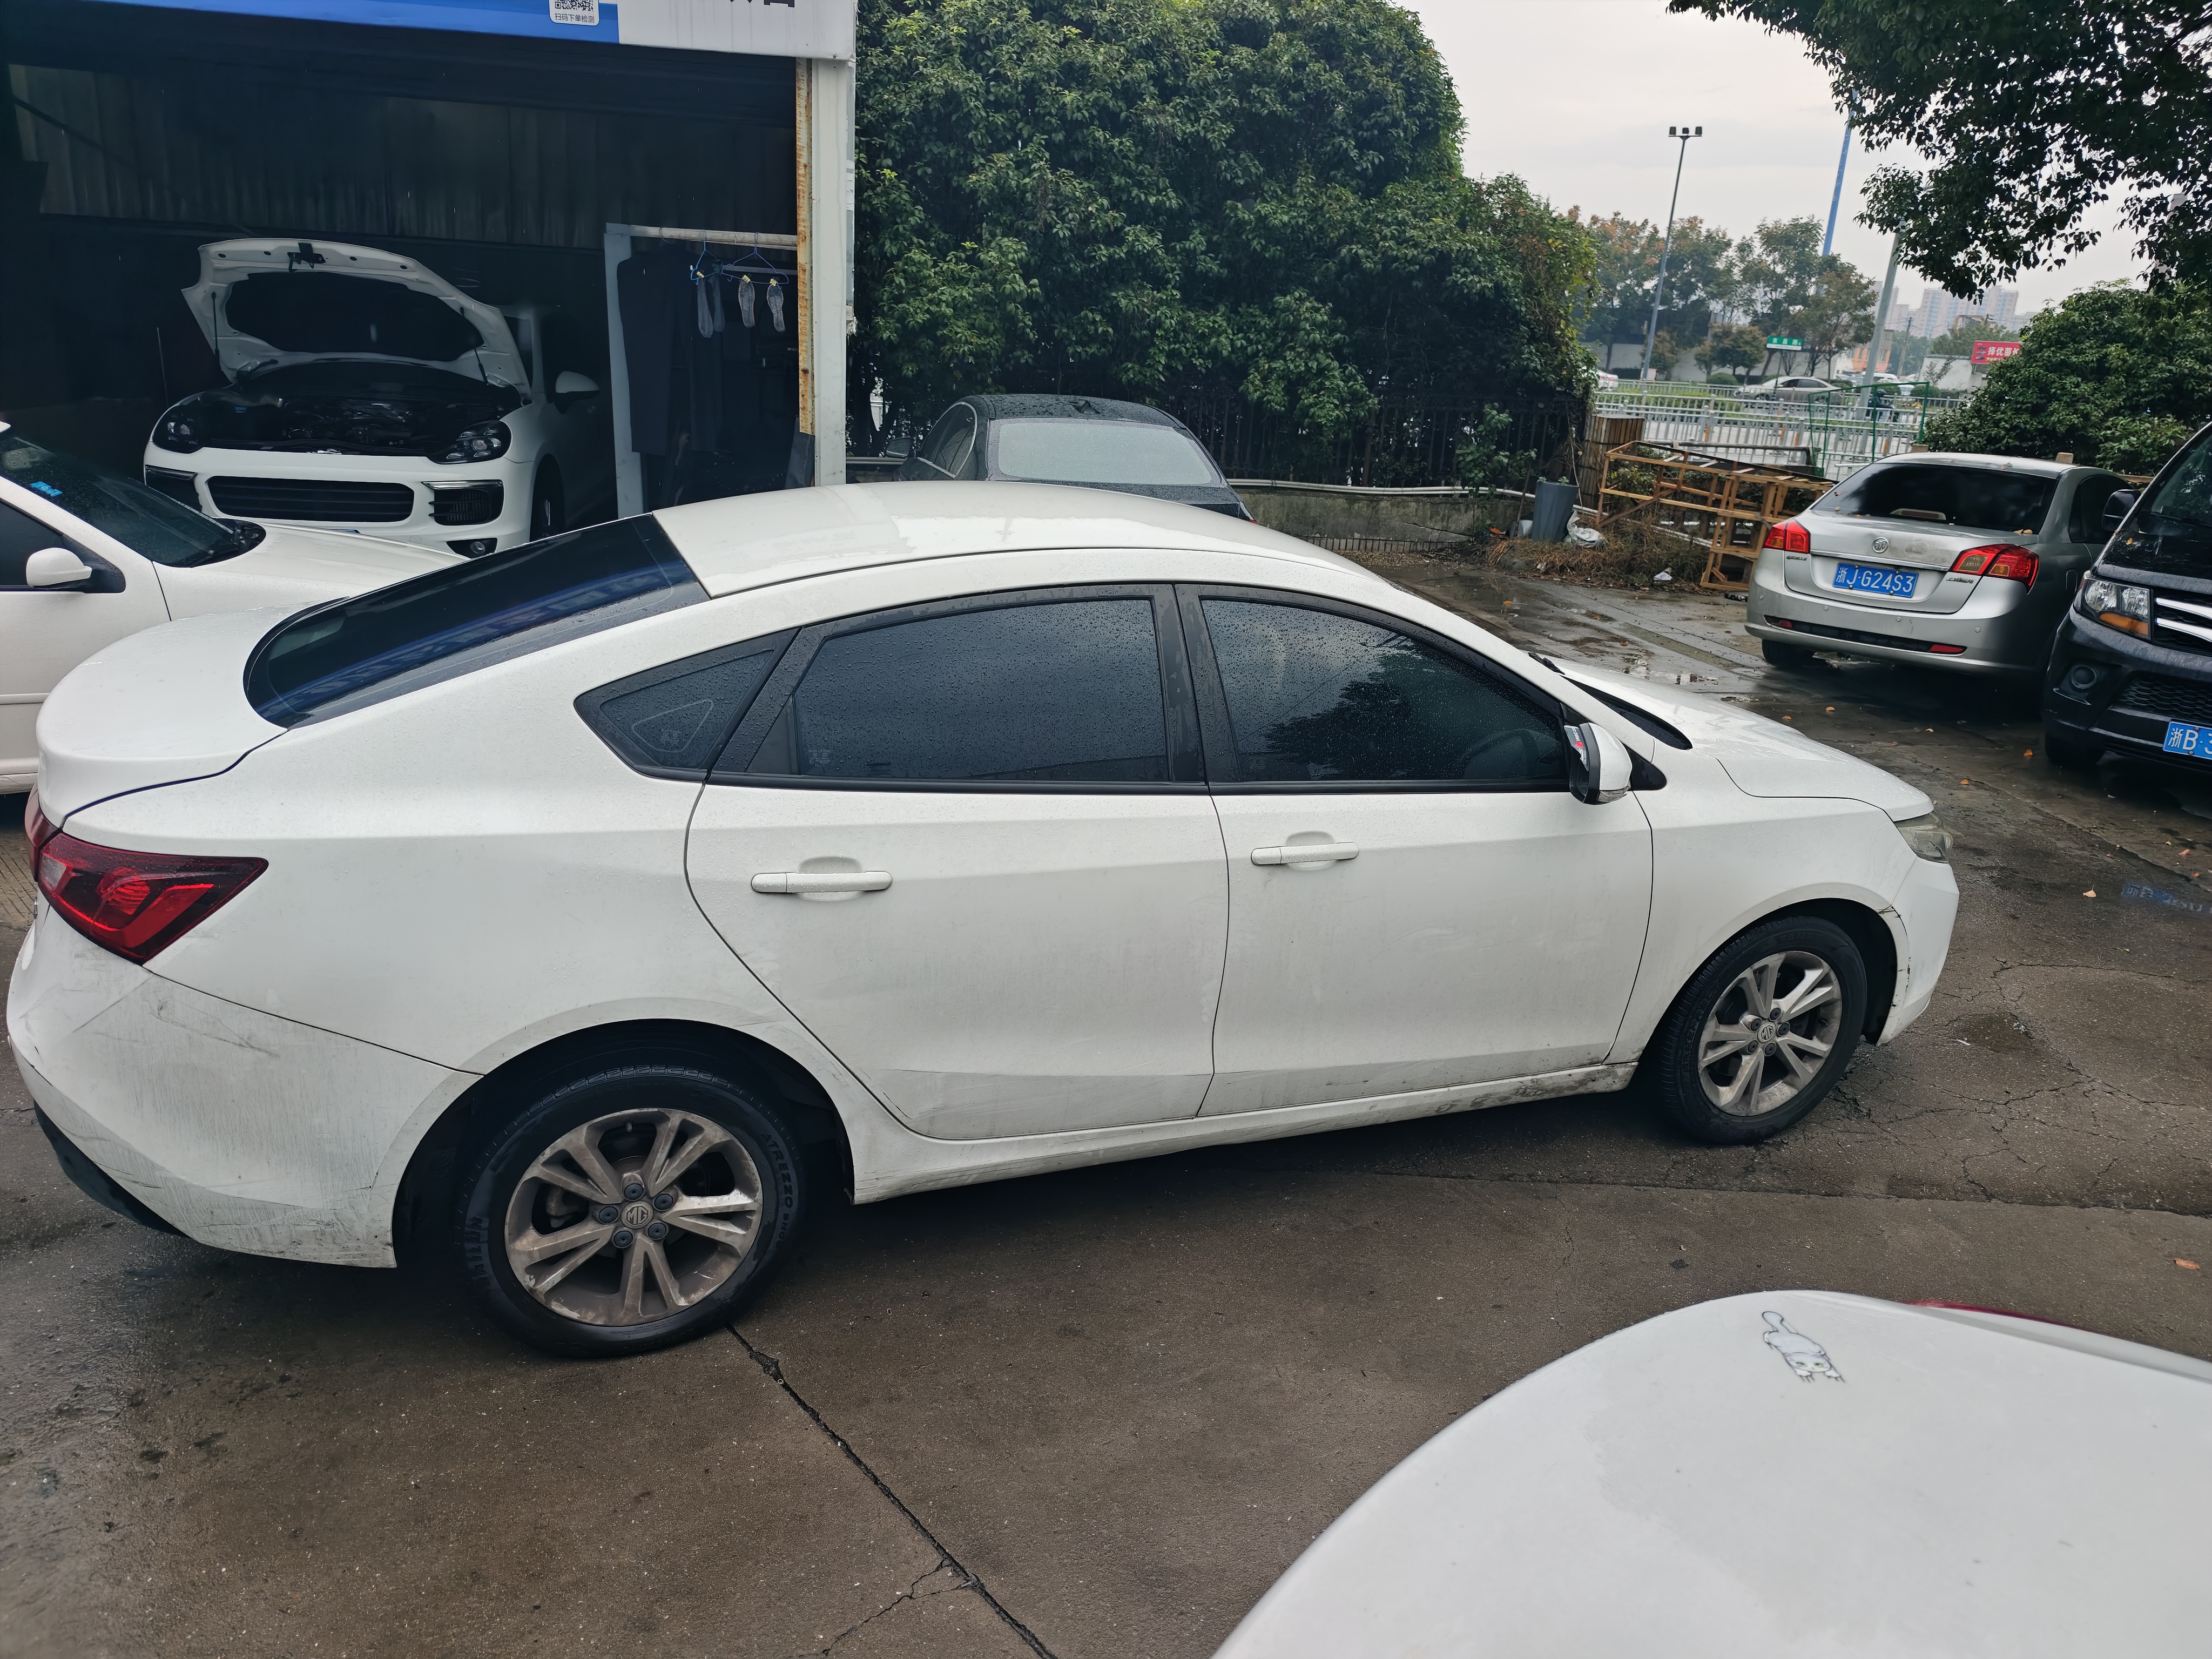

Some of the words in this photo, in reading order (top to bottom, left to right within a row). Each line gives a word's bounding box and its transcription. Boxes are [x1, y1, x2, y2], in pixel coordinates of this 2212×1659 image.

[555, 12, 595, 23] 扫码下单检测
[1761, 1026, 1773, 1040] MG
[626, 1206, 648, 1225] MG
